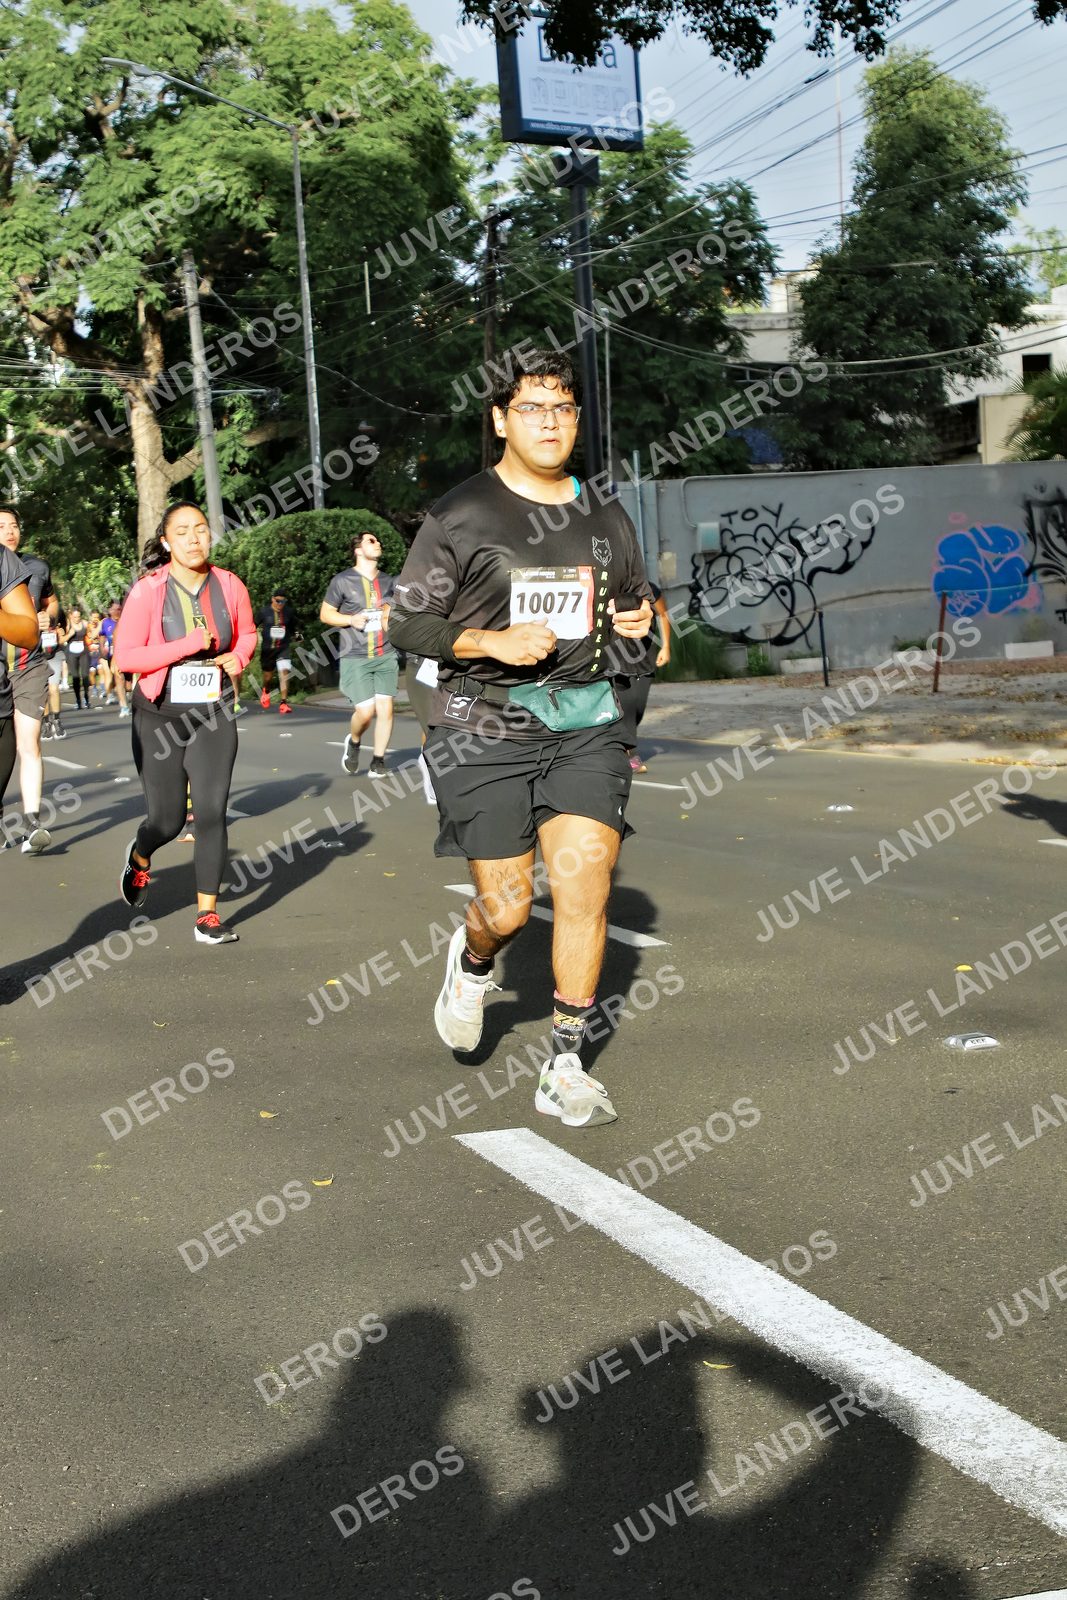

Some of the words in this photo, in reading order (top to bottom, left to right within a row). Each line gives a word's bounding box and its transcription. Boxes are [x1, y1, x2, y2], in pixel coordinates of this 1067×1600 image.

[720, 502, 783, 527] TOY
[516, 591, 583, 614] 10077
[590, 571, 608, 672] RUNNERS
[180, 672, 214, 687] 9807
